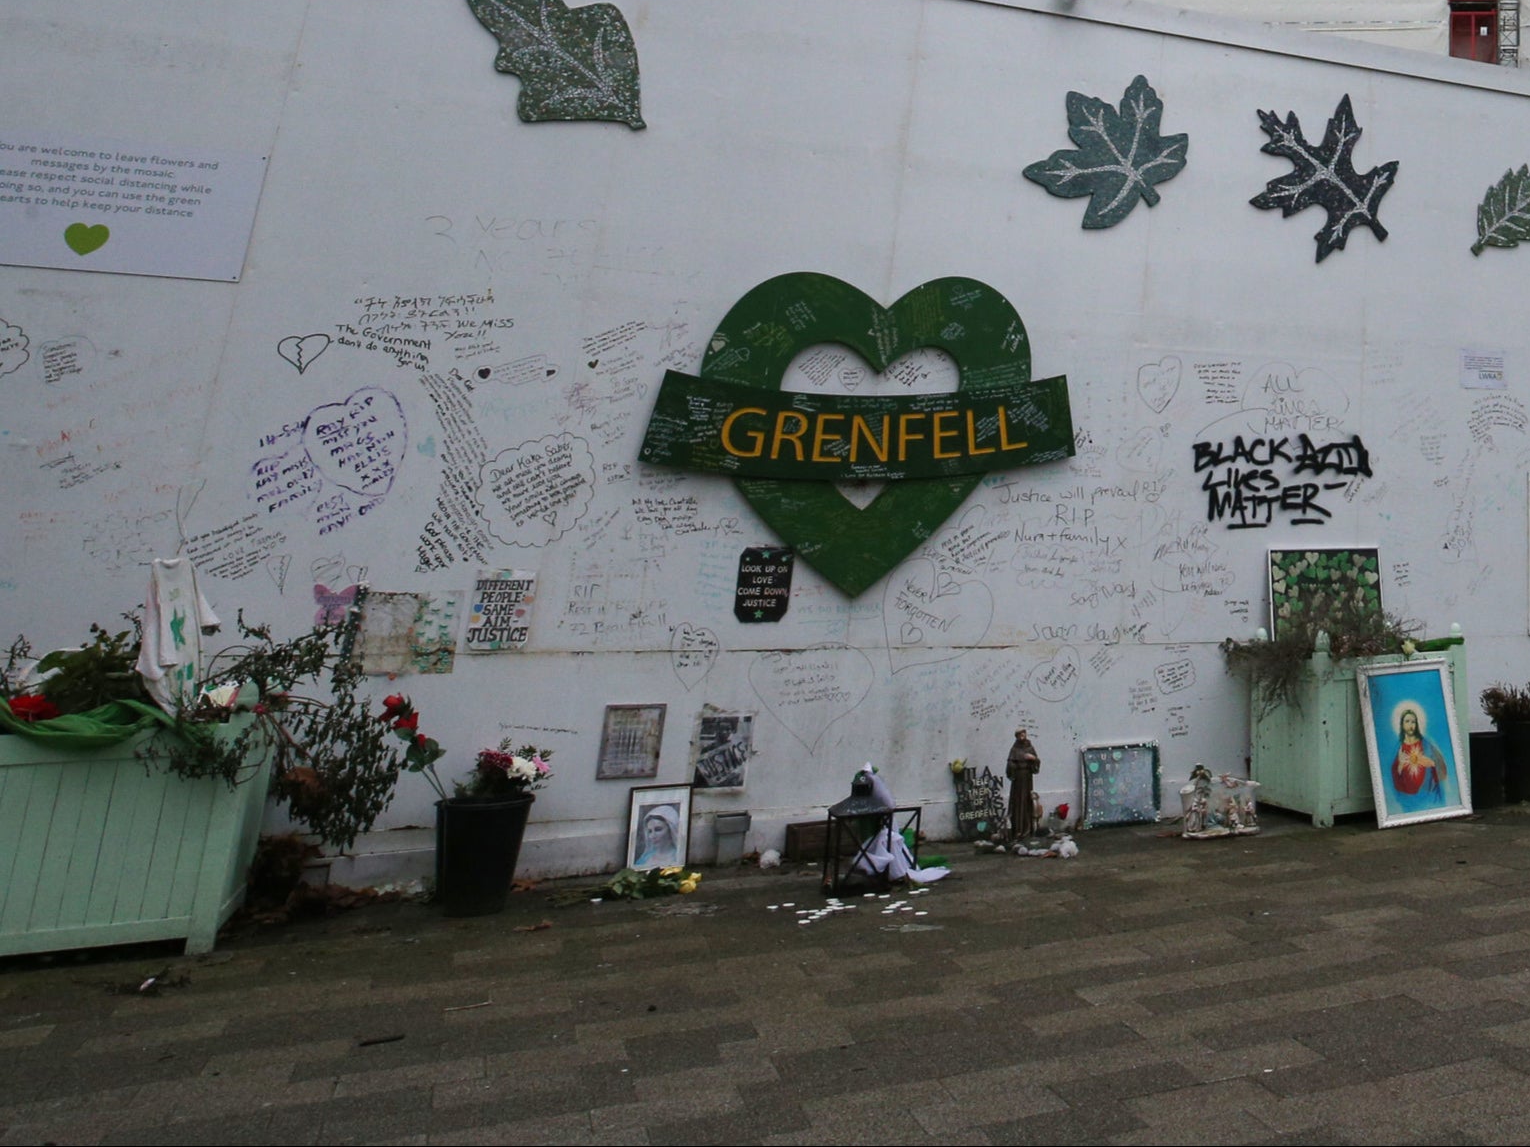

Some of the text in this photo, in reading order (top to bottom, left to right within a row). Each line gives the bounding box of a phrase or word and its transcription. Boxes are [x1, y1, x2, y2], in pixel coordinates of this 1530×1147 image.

[0, 142, 219, 171] ou are welcome to leave flowers and
[31, 157, 89, 171] messages
[93, 162, 107, 174] by
[110, 165, 130, 175] the
[30, 171, 76, 185] respect
[80, 175, 115, 186] social
[119, 178, 178, 194] distancing
[180, 184, 213, 195] while
[35, 196, 48, 205] to
[51, 196, 79, 209] help
[80, 199, 112, 212] keep
[114, 203, 142, 214] your
[144, 206, 194, 218] distance
[48, 185, 70, 195] and
[72, 188, 95, 199] you
[98, 190, 119, 199] can
[122, 192, 143, 201] use
[145, 193, 166, 203] the
[168, 196, 201, 207] green
[362, 326, 432, 351] Government
[365, 341, 378, 351] do
[719, 405, 1029, 463] GRENFELL
[1192, 435, 1294, 473] BLACK
[993, 481, 1052, 504] Justice
[1059, 485, 1085, 500] will
[1207, 482, 1332, 523] MATTER
[1055, 503, 1095, 526] RIP
[740, 564, 762, 573] LOOK
[764, 565, 776, 573] UP
[752, 575, 773, 584] LOVE
[475, 579, 534, 591] DIFFERENT
[737, 587, 761, 596] COME
[482, 604, 514, 616] SAME
[742, 599, 777, 607] JUSTICE
[895, 591, 960, 633] FORGOTTEN
[466, 627, 529, 643] JUSTICE
